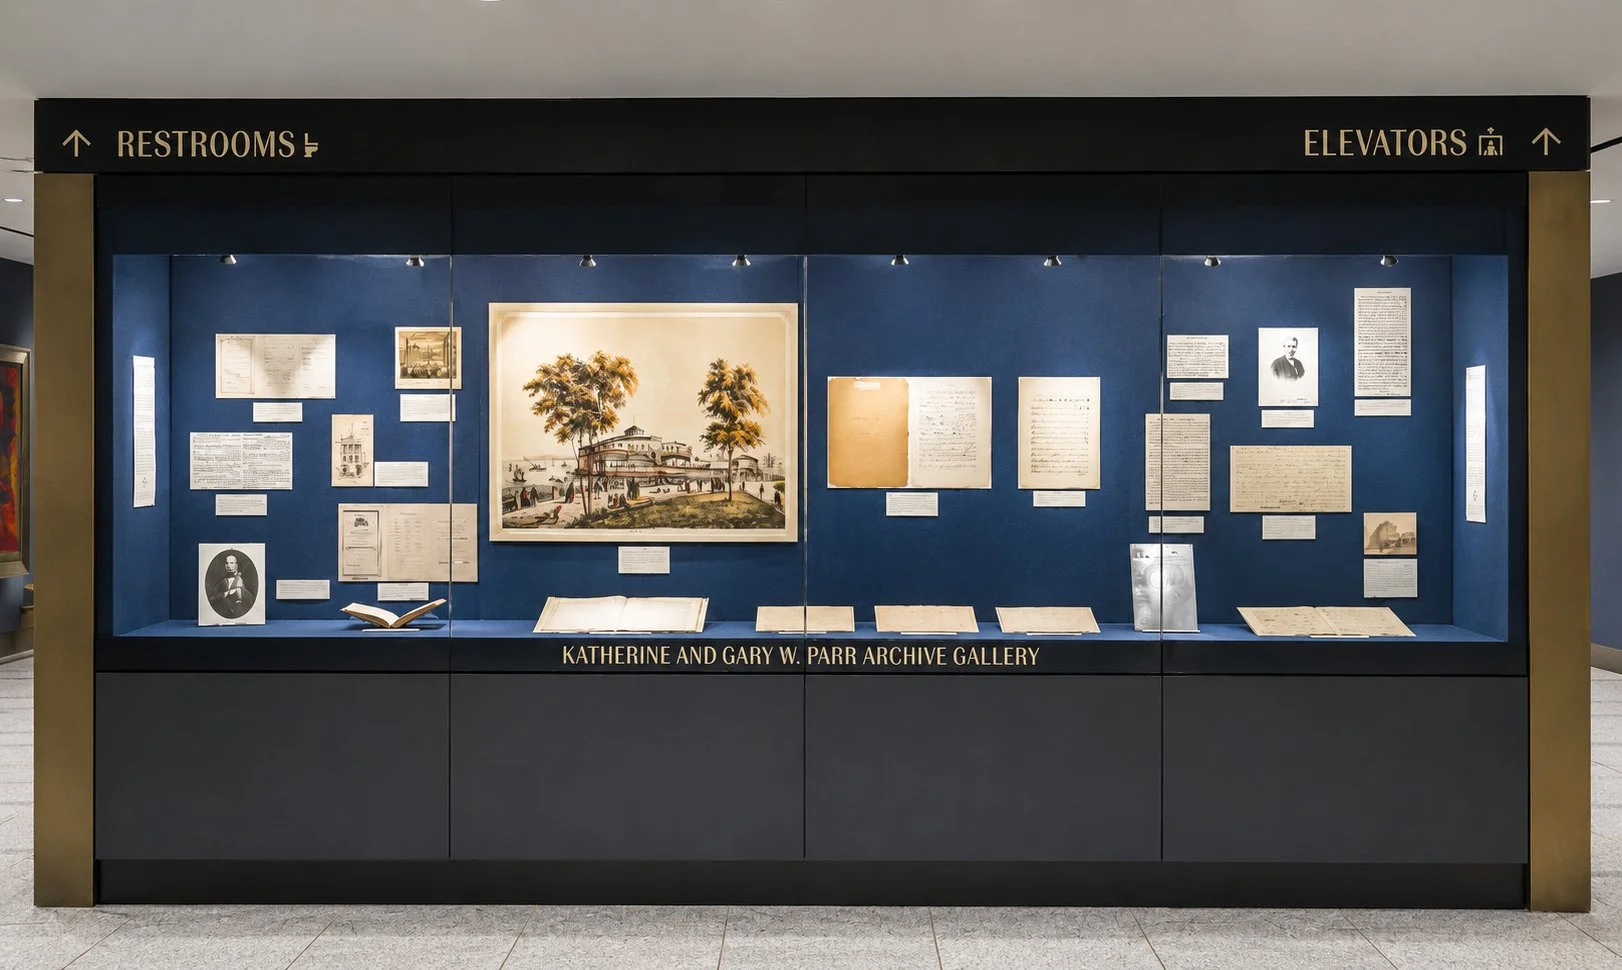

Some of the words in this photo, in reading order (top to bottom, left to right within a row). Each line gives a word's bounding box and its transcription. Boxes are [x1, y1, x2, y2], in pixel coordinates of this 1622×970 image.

[117, 130, 295, 158] RESTROOMS
[1304, 128, 1467, 157] ELEVATORS
[562, 645, 671, 665] KATHERINE
[676, 645, 717, 665] AND
[722, 645, 774, 665] GARY
[778, 646, 801, 665] W.
[807, 646, 857, 665] PARR
[862, 646, 948, 666] ARCHIVE
[952, 646, 1040, 666] GALLERY
